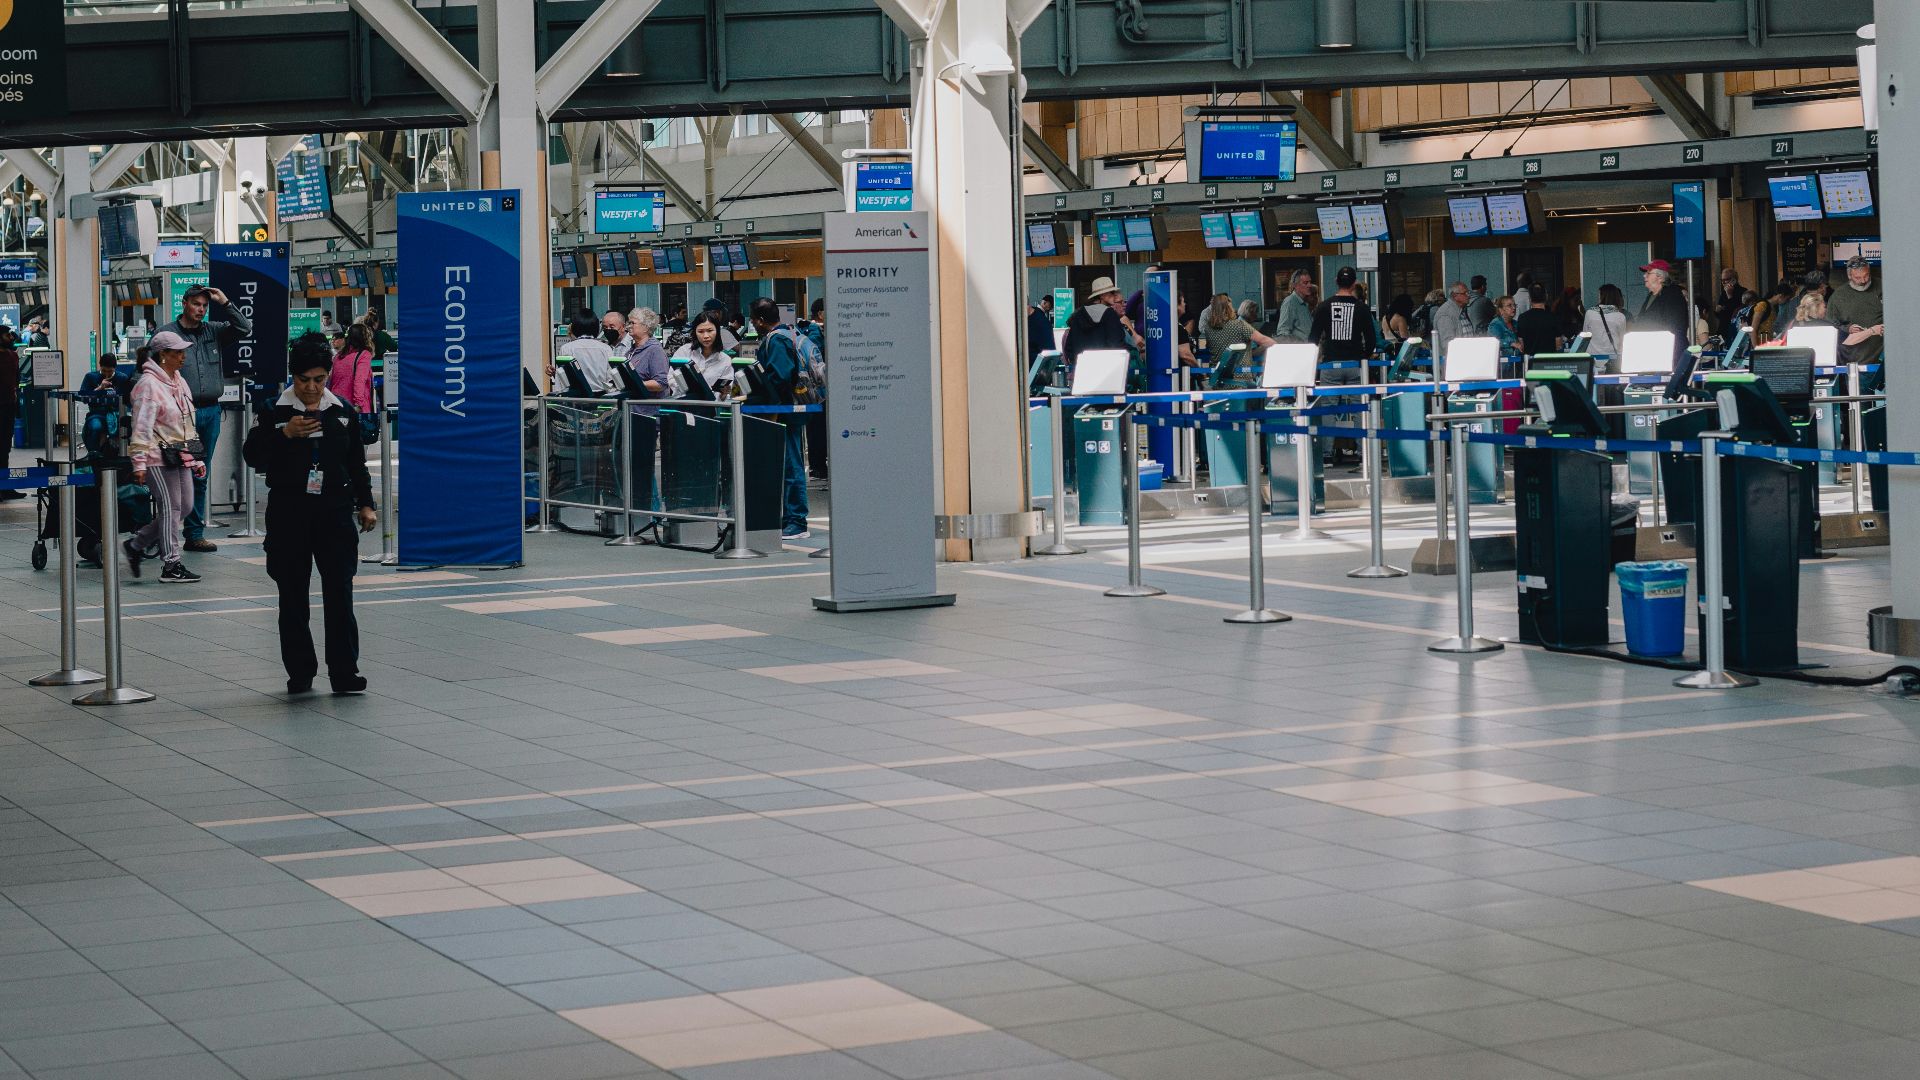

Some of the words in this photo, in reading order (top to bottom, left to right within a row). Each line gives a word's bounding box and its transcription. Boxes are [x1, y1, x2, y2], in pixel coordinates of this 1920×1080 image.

[0, 49, 38, 60] oom
[1775, 142, 1788, 152] 271
[1686, 149, 1699, 159] 270
[1603, 156, 1616, 167] 269
[1526, 162, 1538, 173] 268
[1386, 173, 1397, 183] 266
[1453, 168, 1465, 178] 267
[1263, 182, 1273, 191] 264
[1323, 178, 1334, 187] 265
[858, 196, 899, 207] WESTJET
[421, 202, 475, 212] UNITED
[600, 210, 638, 220] WESTJET
[855, 227, 902, 237] American
[226, 250, 261, 258] UNITED
[837, 266, 898, 278] PRIORITY
[837, 286, 871, 294] Customer
[873, 285, 909, 293] Assistance
[440, 265, 470, 418] Economy
[866, 340, 894, 348] Economy
